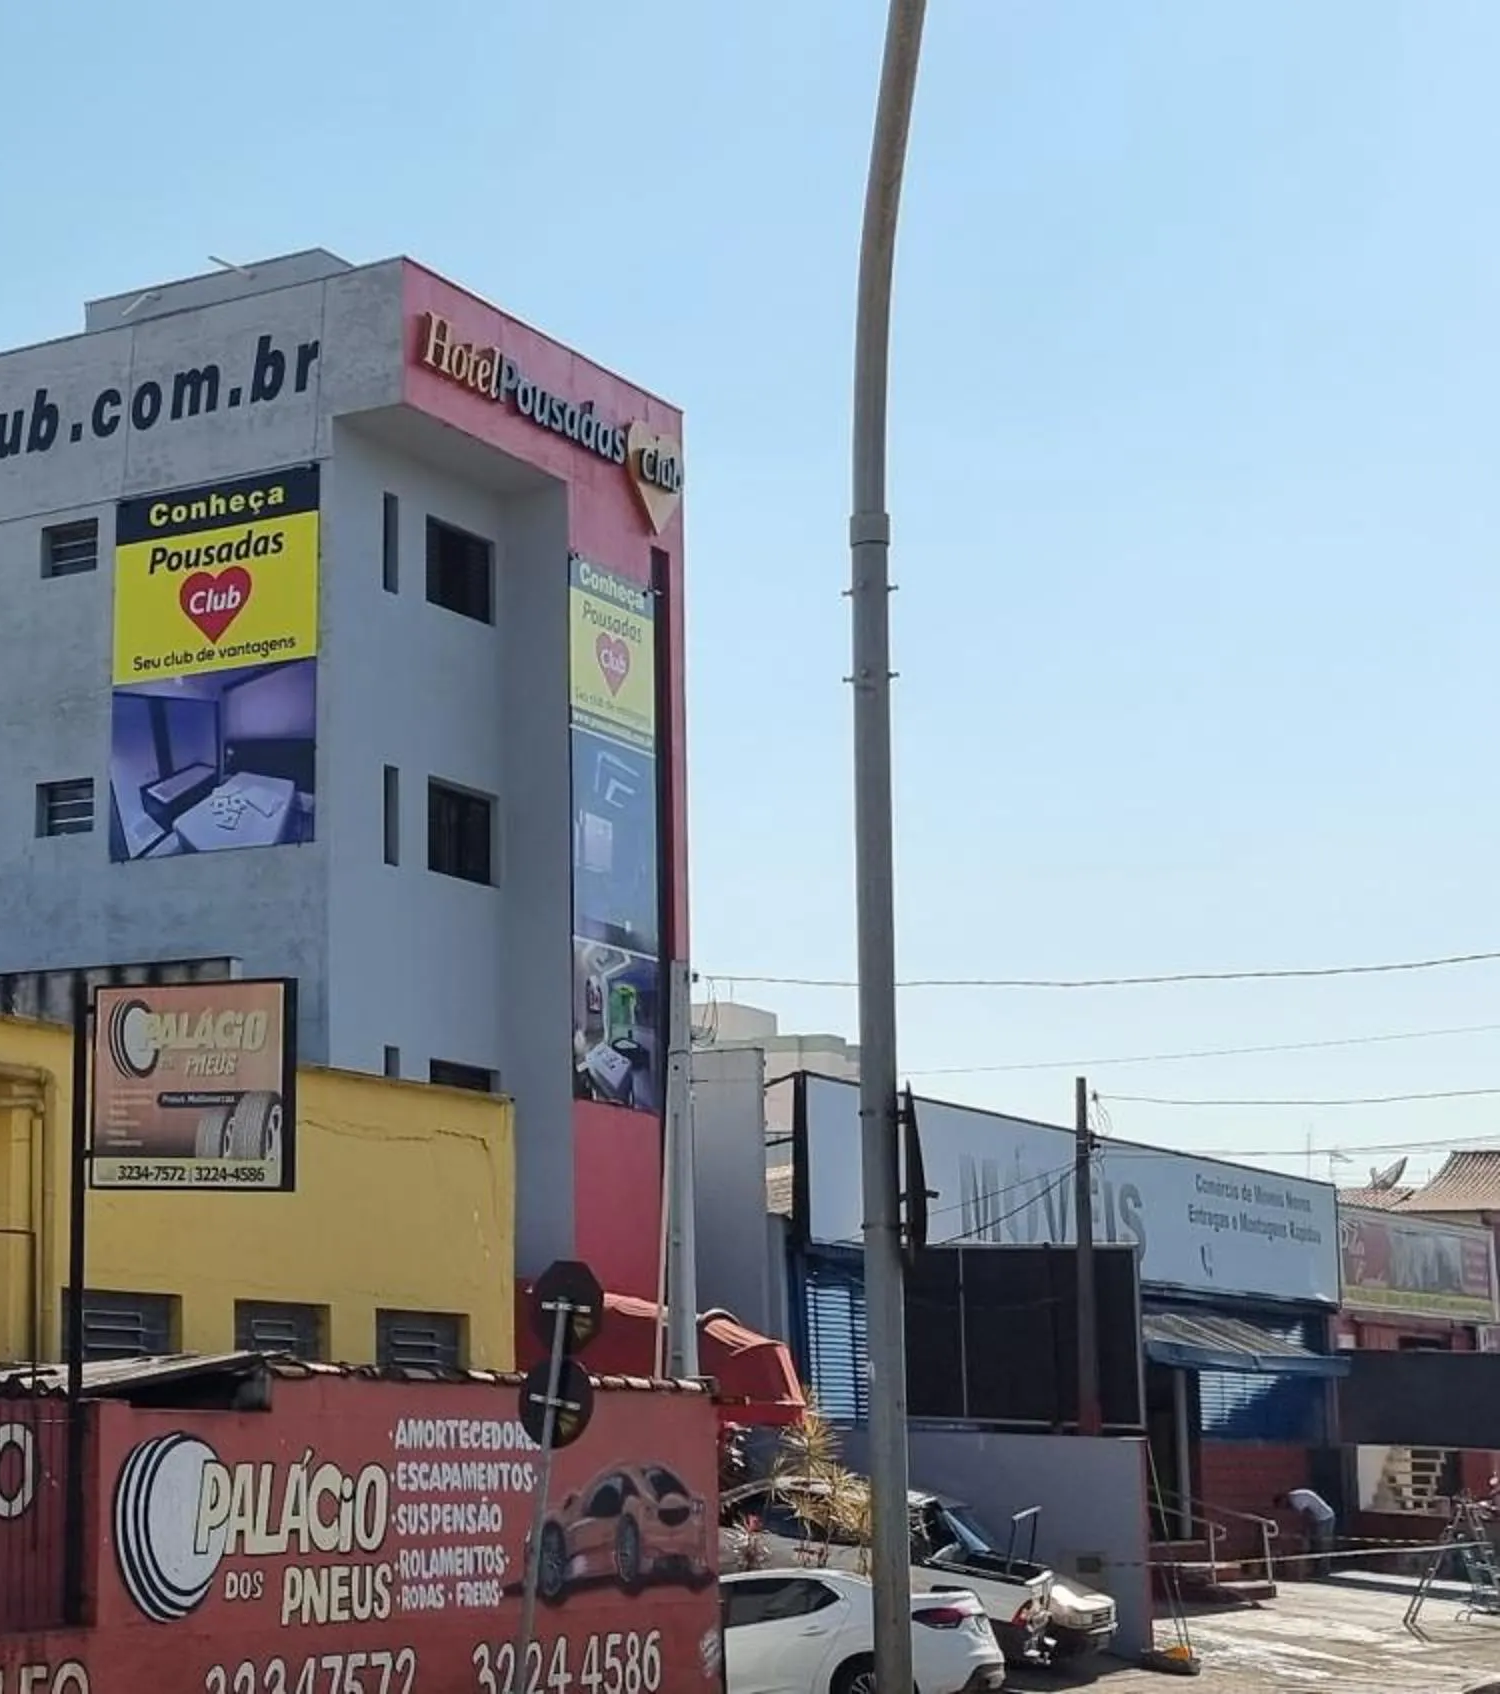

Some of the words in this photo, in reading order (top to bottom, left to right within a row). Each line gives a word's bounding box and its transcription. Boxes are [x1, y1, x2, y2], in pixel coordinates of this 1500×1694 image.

[423, 310, 501, 400] Hotel
[500, 356, 627, 465] Pousadas
[149, 485, 285, 527] Conheça
[149, 530, 284, 575] Pousadas
[190, 585, 241, 615] Club
[133, 656, 161, 672] Seu
[163, 651, 193, 669] club
[196, 647, 215, 663] de
[219, 635, 296, 658] vantagens
[118, 1164, 186, 1182] 3234-7572
[395, 1418, 541, 1450] AMORTECEDOR
[397, 1460, 534, 1493] ESCAPAMENTOS
[399, 1545, 505, 1579] ROLAMENTOS
[224, 1571, 264, 1600] DOS
[280, 1563, 393, 1626] PNEUS
[401, 1582, 445, 1610] RODAS
[455, 1579, 500, 1607] FREIOS
